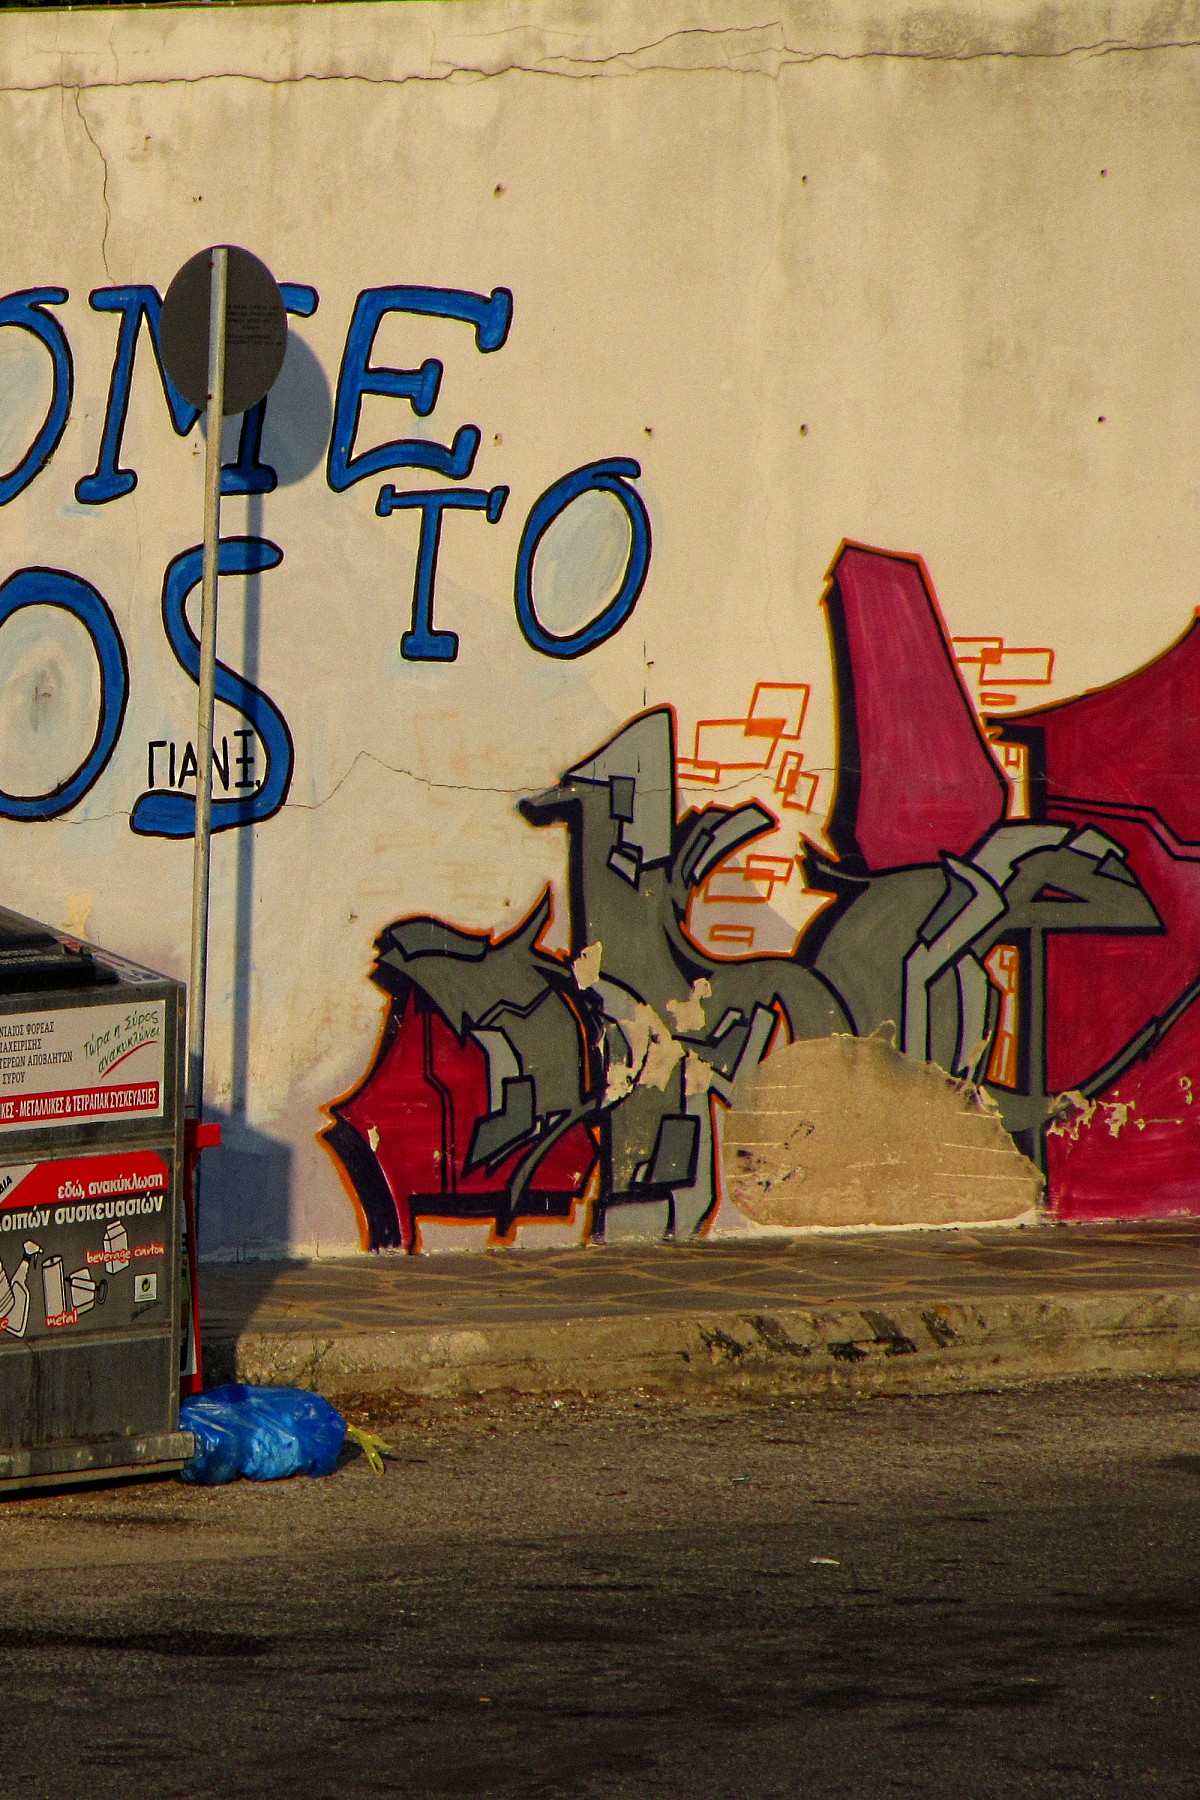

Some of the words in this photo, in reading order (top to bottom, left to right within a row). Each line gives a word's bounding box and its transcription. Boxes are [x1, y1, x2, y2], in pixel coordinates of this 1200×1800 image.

[376, 456, 654, 662] TO
[26, 1021, 55, 1036] ΦΟΡΕΑΣ
[114, 1023, 121, 1040] η
[124, 1009, 159, 1033] Σύρος
[27, 1051, 73, 1067] ΑΠΟΒΛΗΤΩΝ
[98, 1025, 160, 1074] ανακυκλώνει
[2, 1071, 26, 1085] ΣΥΡΟΥ
[19, 1096, 64, 1118] ΜΕΤΑΛΛΙΚΕΣ
[65, 1097, 71, 1112] &
[72, 1092, 110, 1112] ΤΕΤΡΑΠΑΚ
[110, 1087, 157, 1109] ΣΥΣΚΕΥΑΣΙΕΣ
[57, 1179, 86, 1200] εδώ,
[88, 1172, 163, 1196] ανακύκλωση
[54, 1191, 164, 1226] συσκευασιών
[86, 1249, 131, 1265] beverage
[134, 1244, 165, 1257] carton
[46, 1312, 78, 1327] metal
